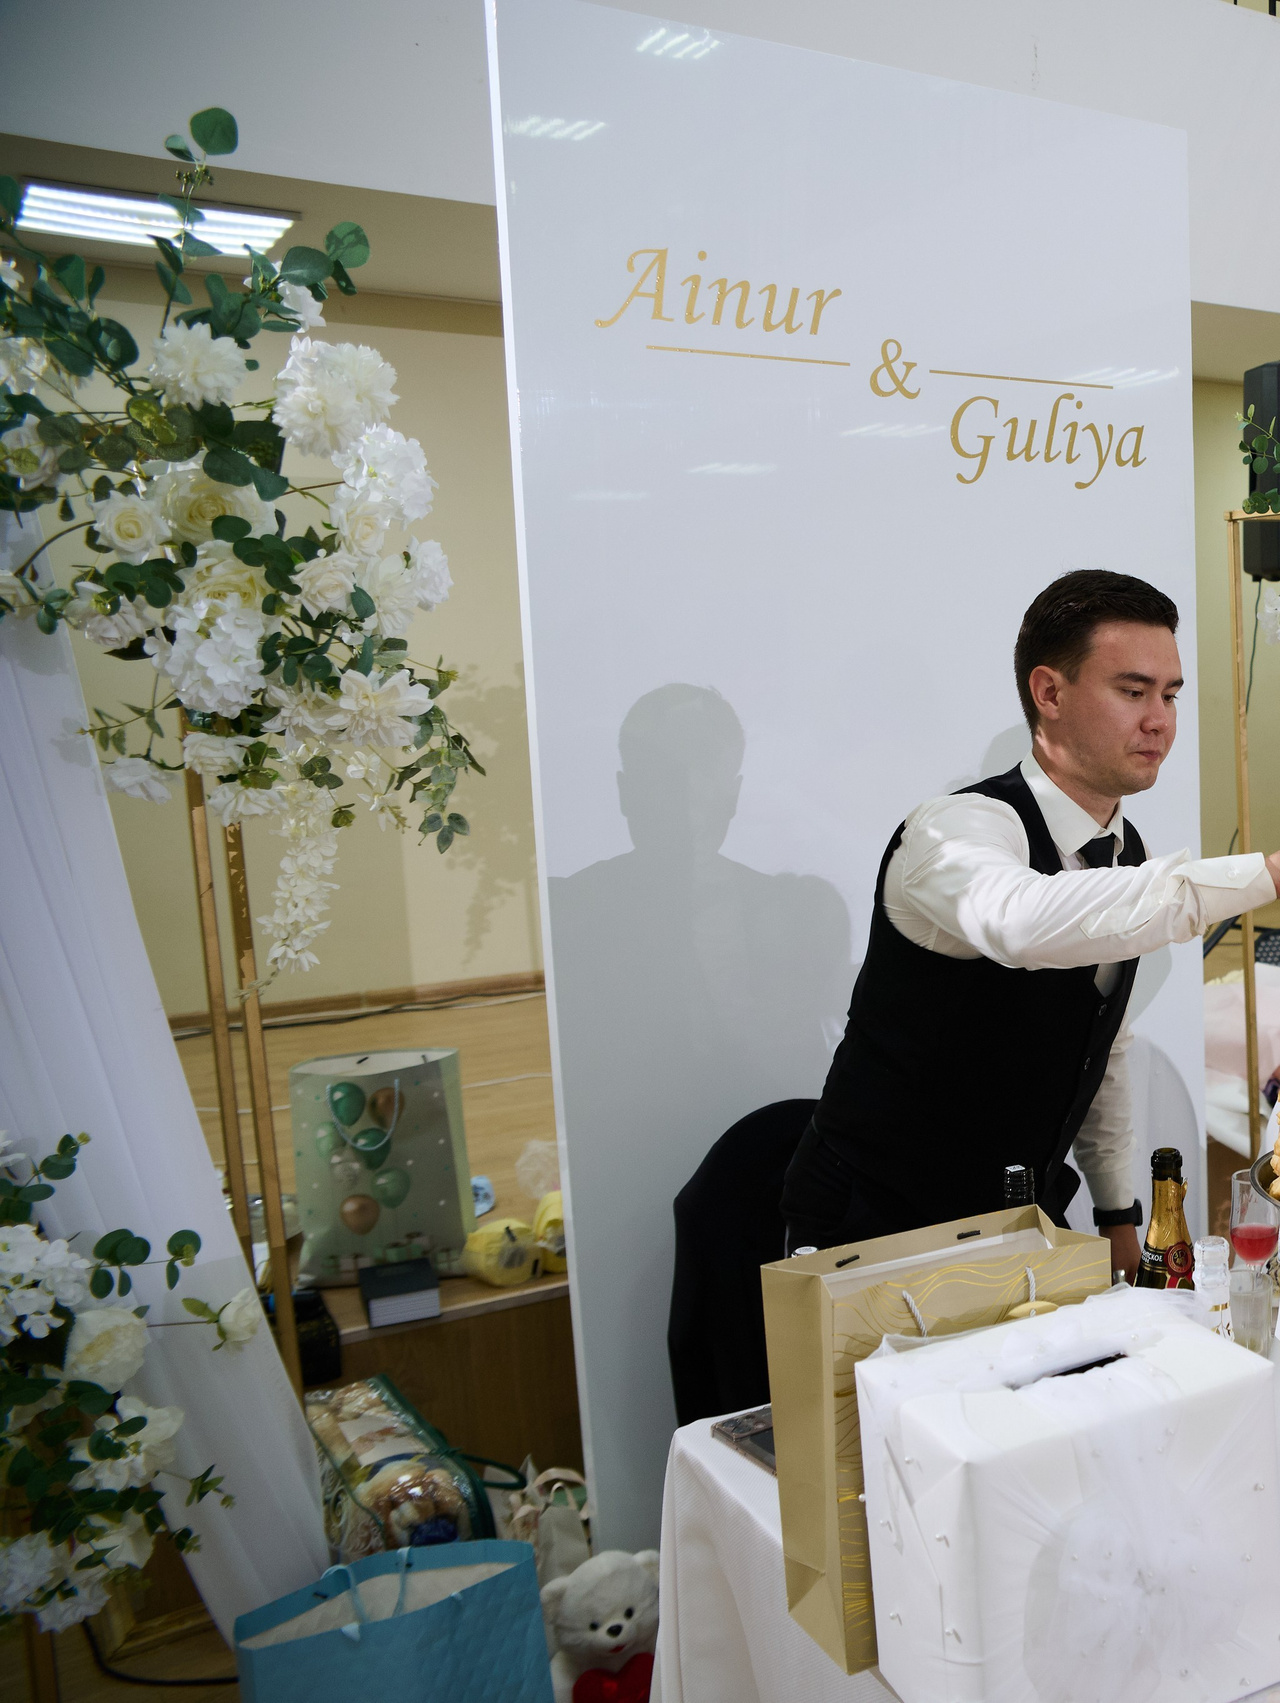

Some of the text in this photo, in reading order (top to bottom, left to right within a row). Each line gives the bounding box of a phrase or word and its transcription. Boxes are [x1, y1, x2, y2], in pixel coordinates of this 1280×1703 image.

[594, 247, 842, 335] Ainur
[869, 338, 921, 400] &
[949, 392, 1147, 490] Guliya
